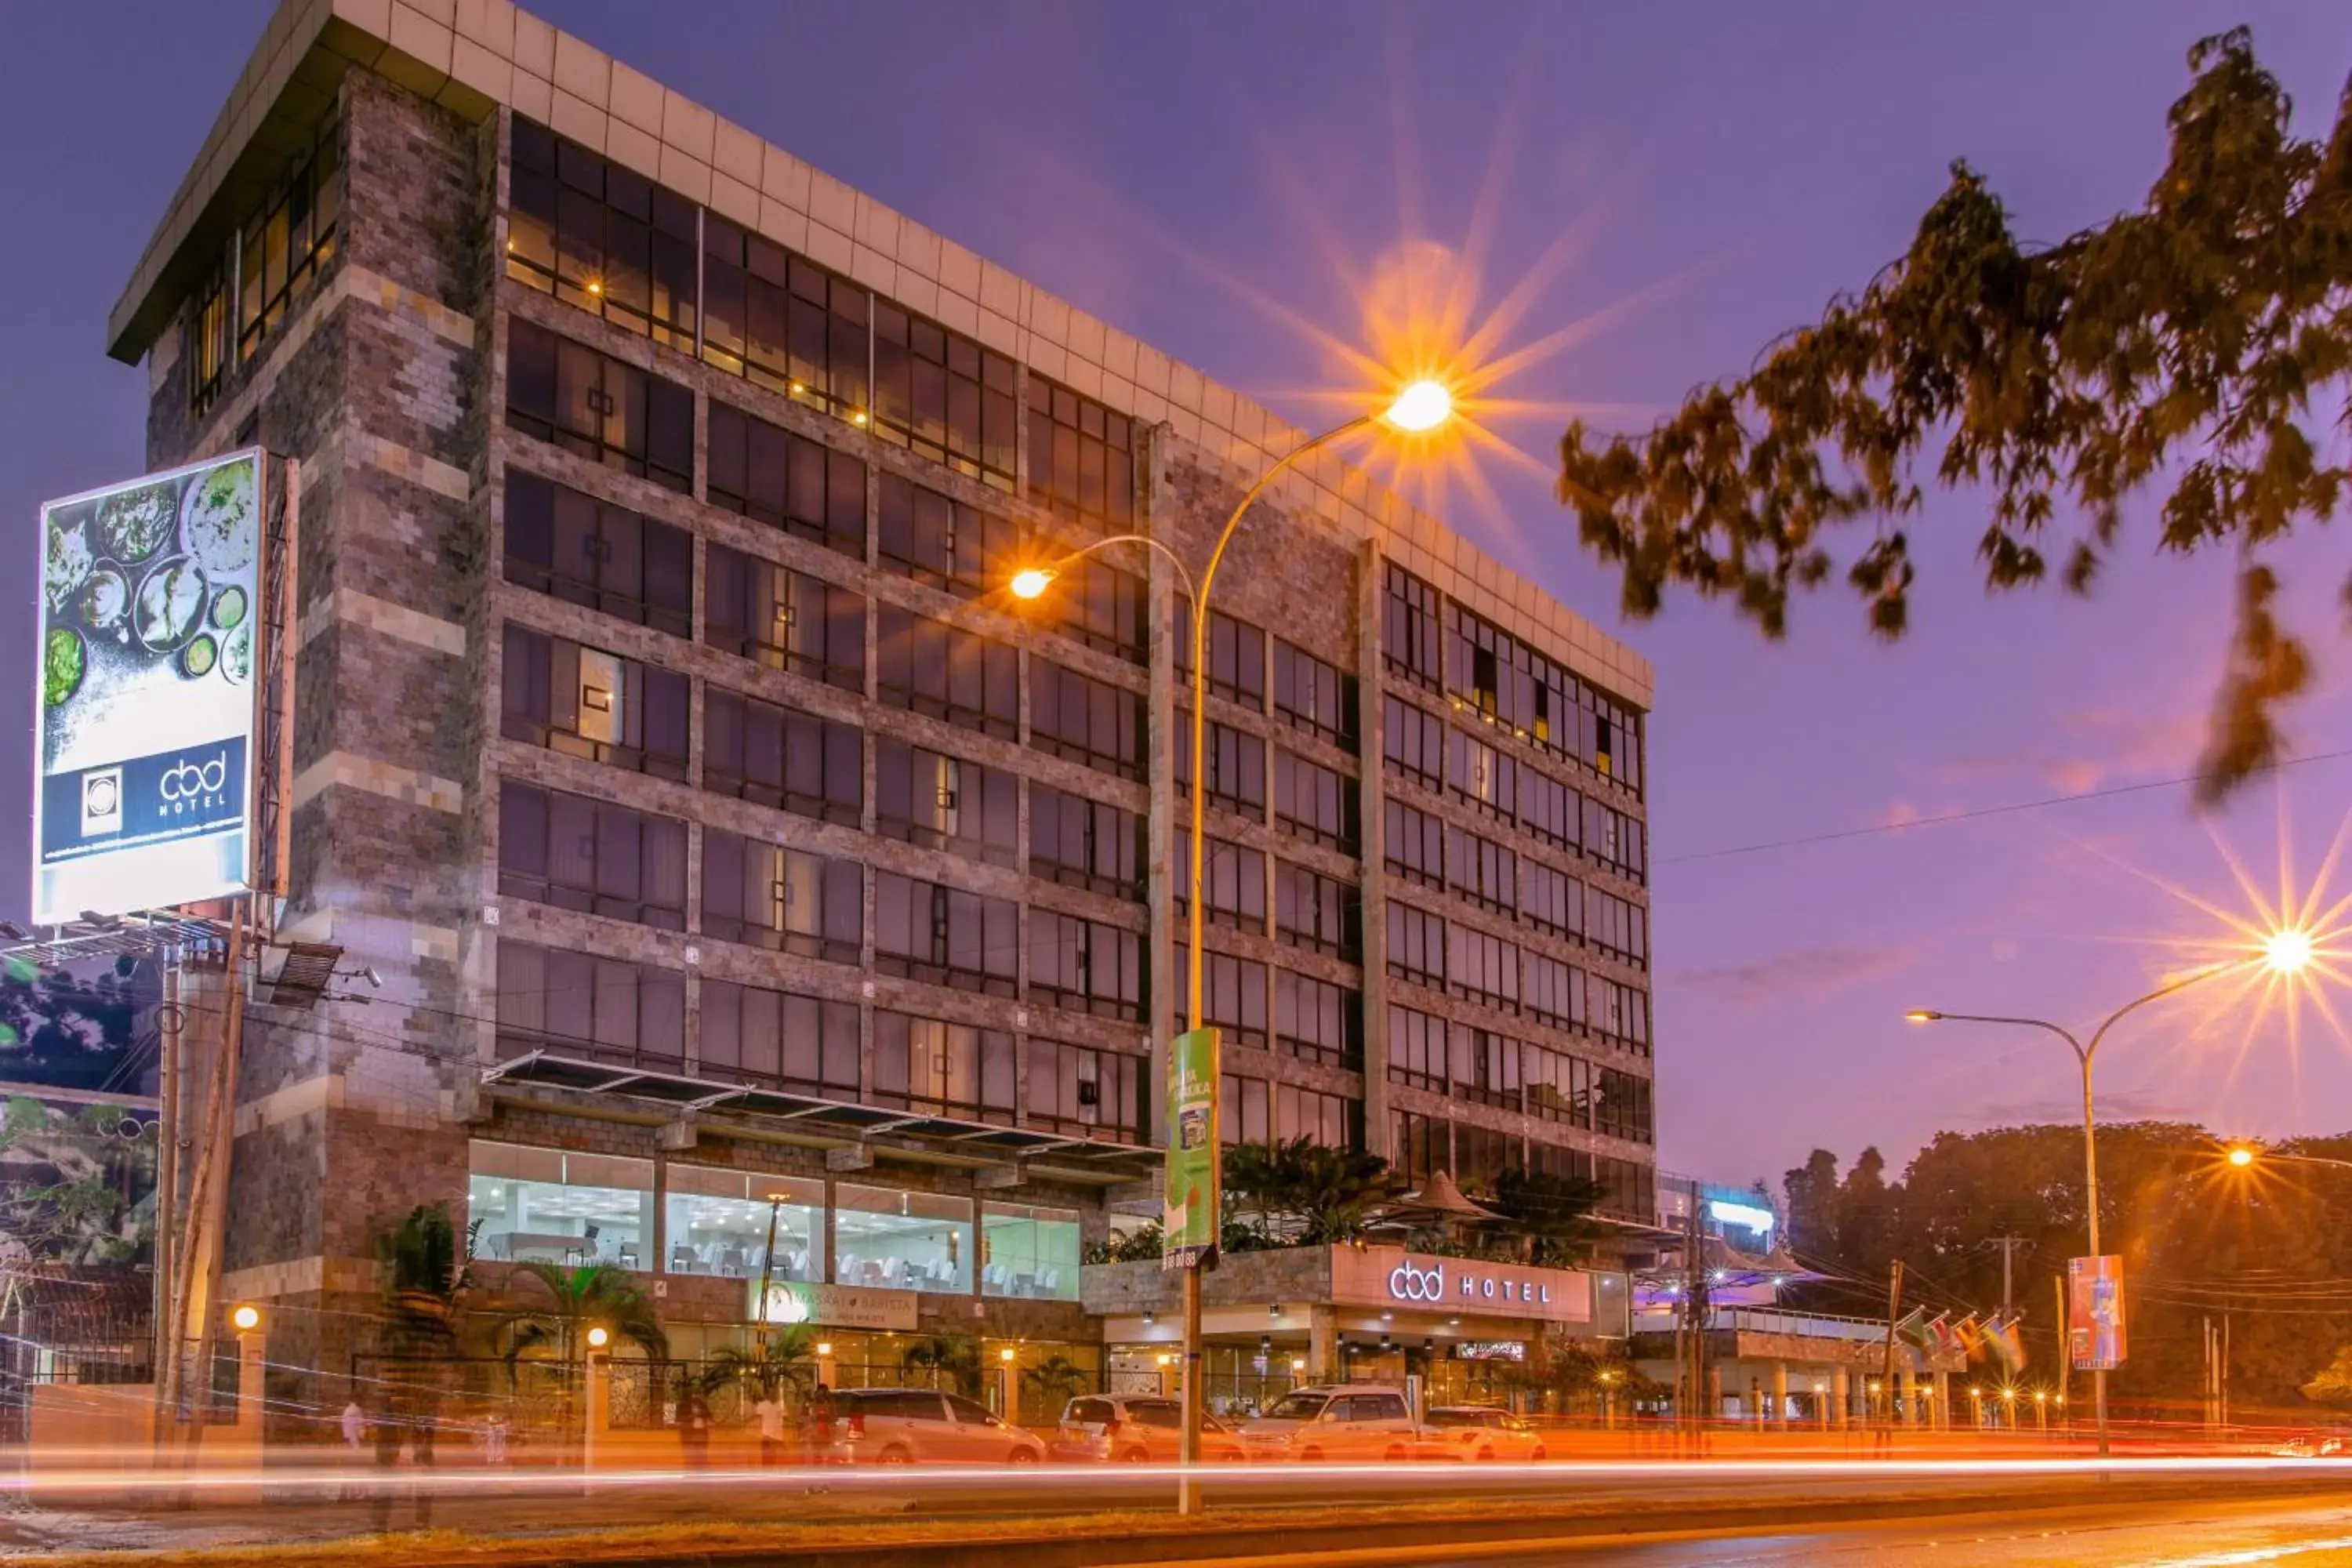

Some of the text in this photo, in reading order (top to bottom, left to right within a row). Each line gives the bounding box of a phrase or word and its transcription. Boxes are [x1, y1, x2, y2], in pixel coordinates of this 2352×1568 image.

[160, 750, 226, 800] cbd
[159, 793, 225, 816] HOTEL
[1391, 1261, 1550, 1303] cbd HOTEL
[861, 1295, 910, 1312] BARISTA
